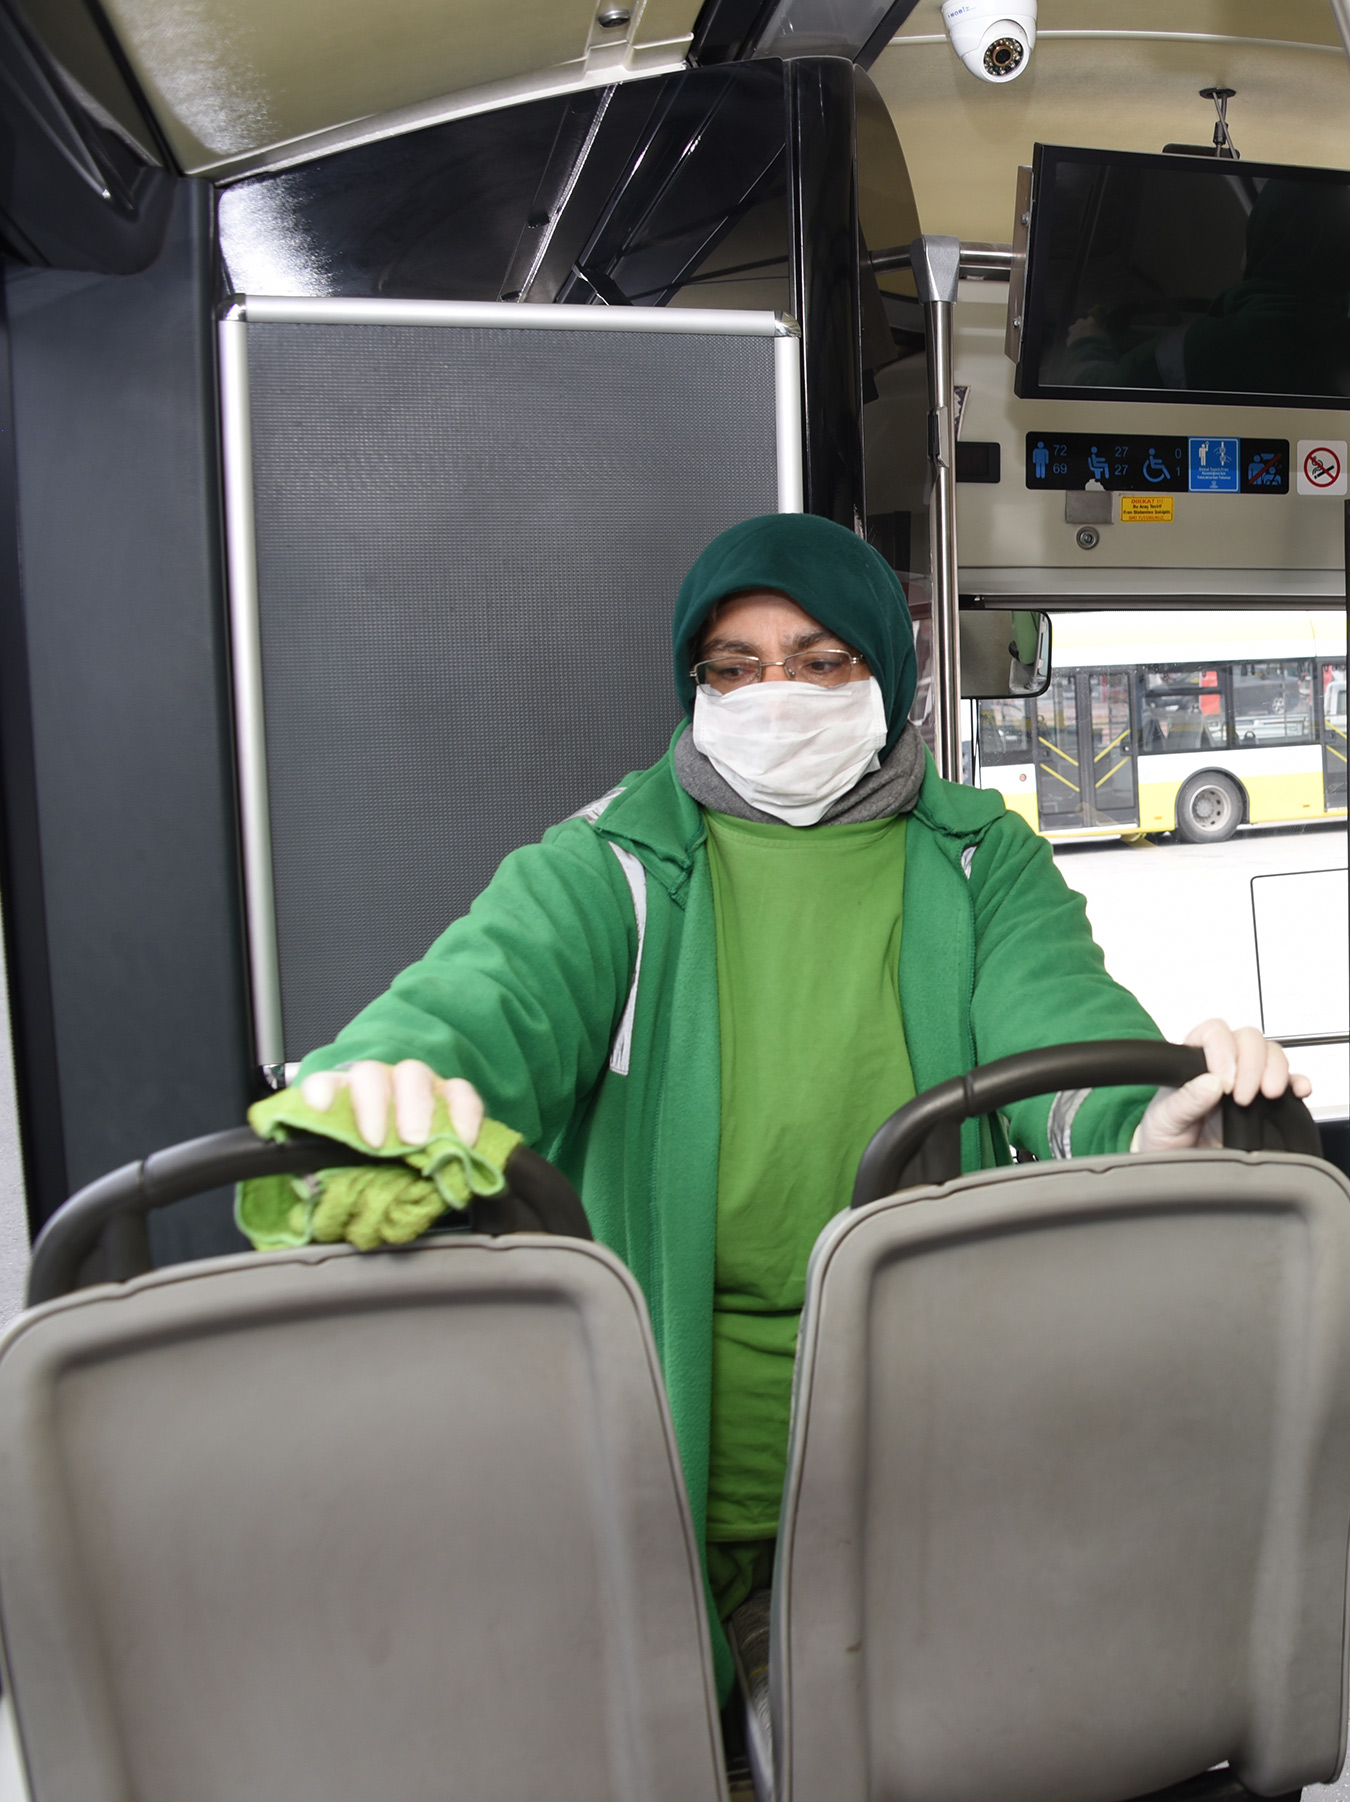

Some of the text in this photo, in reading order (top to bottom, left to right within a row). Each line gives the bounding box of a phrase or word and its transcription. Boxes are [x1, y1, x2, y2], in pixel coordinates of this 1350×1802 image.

[1053, 444, 1067, 456] 72
[1114, 446, 1128, 458] 27
[1174, 448, 1182, 459] 0
[1052, 463, 1068, 475] 69
[1114, 464, 1128, 476] 27
[1175, 466, 1181, 477] 1
